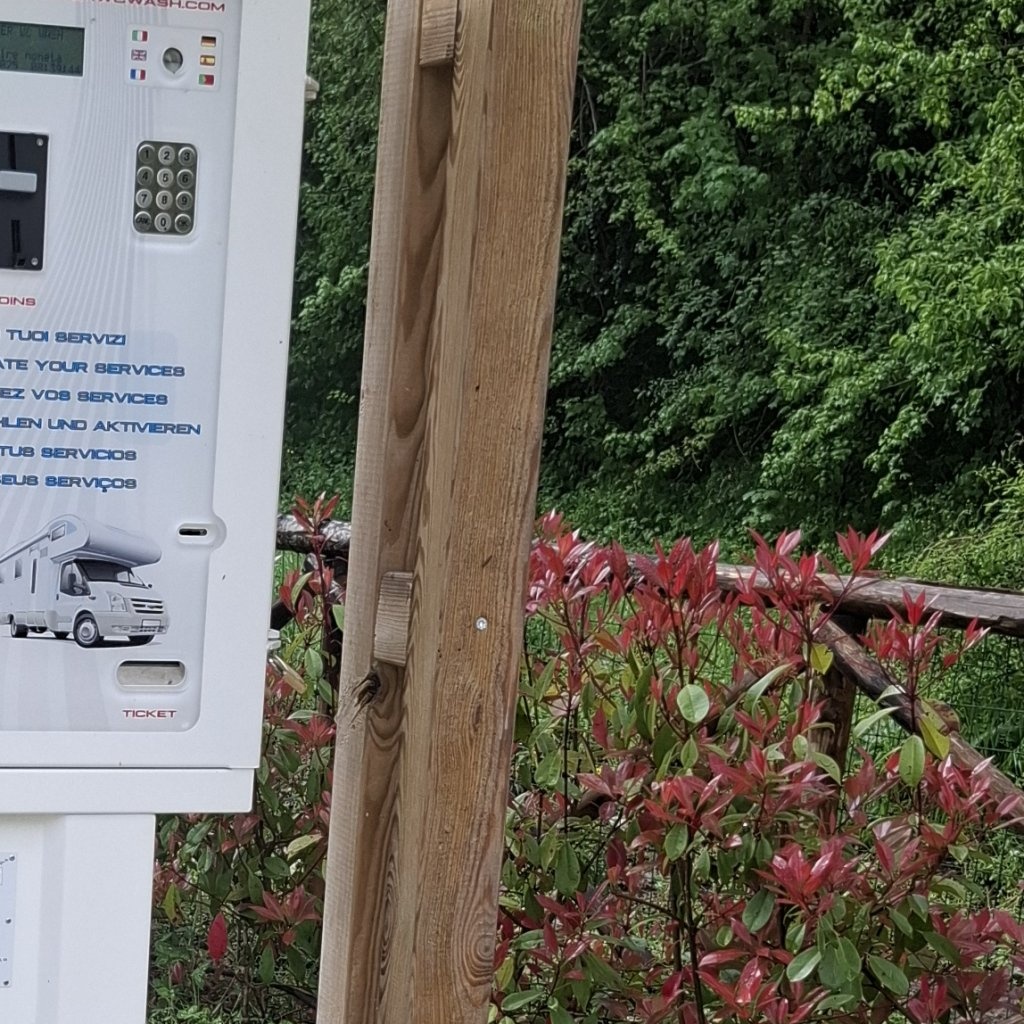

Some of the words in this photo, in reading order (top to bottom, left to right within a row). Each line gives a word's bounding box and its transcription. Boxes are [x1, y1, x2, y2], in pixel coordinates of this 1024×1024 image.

[6, 329, 48, 342] TUOI
[55, 331, 126, 345] SERVIZI
[35, 360, 88, 373] YOUR
[94, 363, 185, 377] SERVICES
[31, 389, 71, 401] VOS
[77, 391, 168, 405] SERVICES
[48, 419, 86, 431] UND
[93, 421, 201, 435] AKTIVIEREN
[41, 447, 136, 461] SERVICIOS
[45, 476, 136, 493] SERVIÇOS
[123, 709, 176, 719] TICKET
